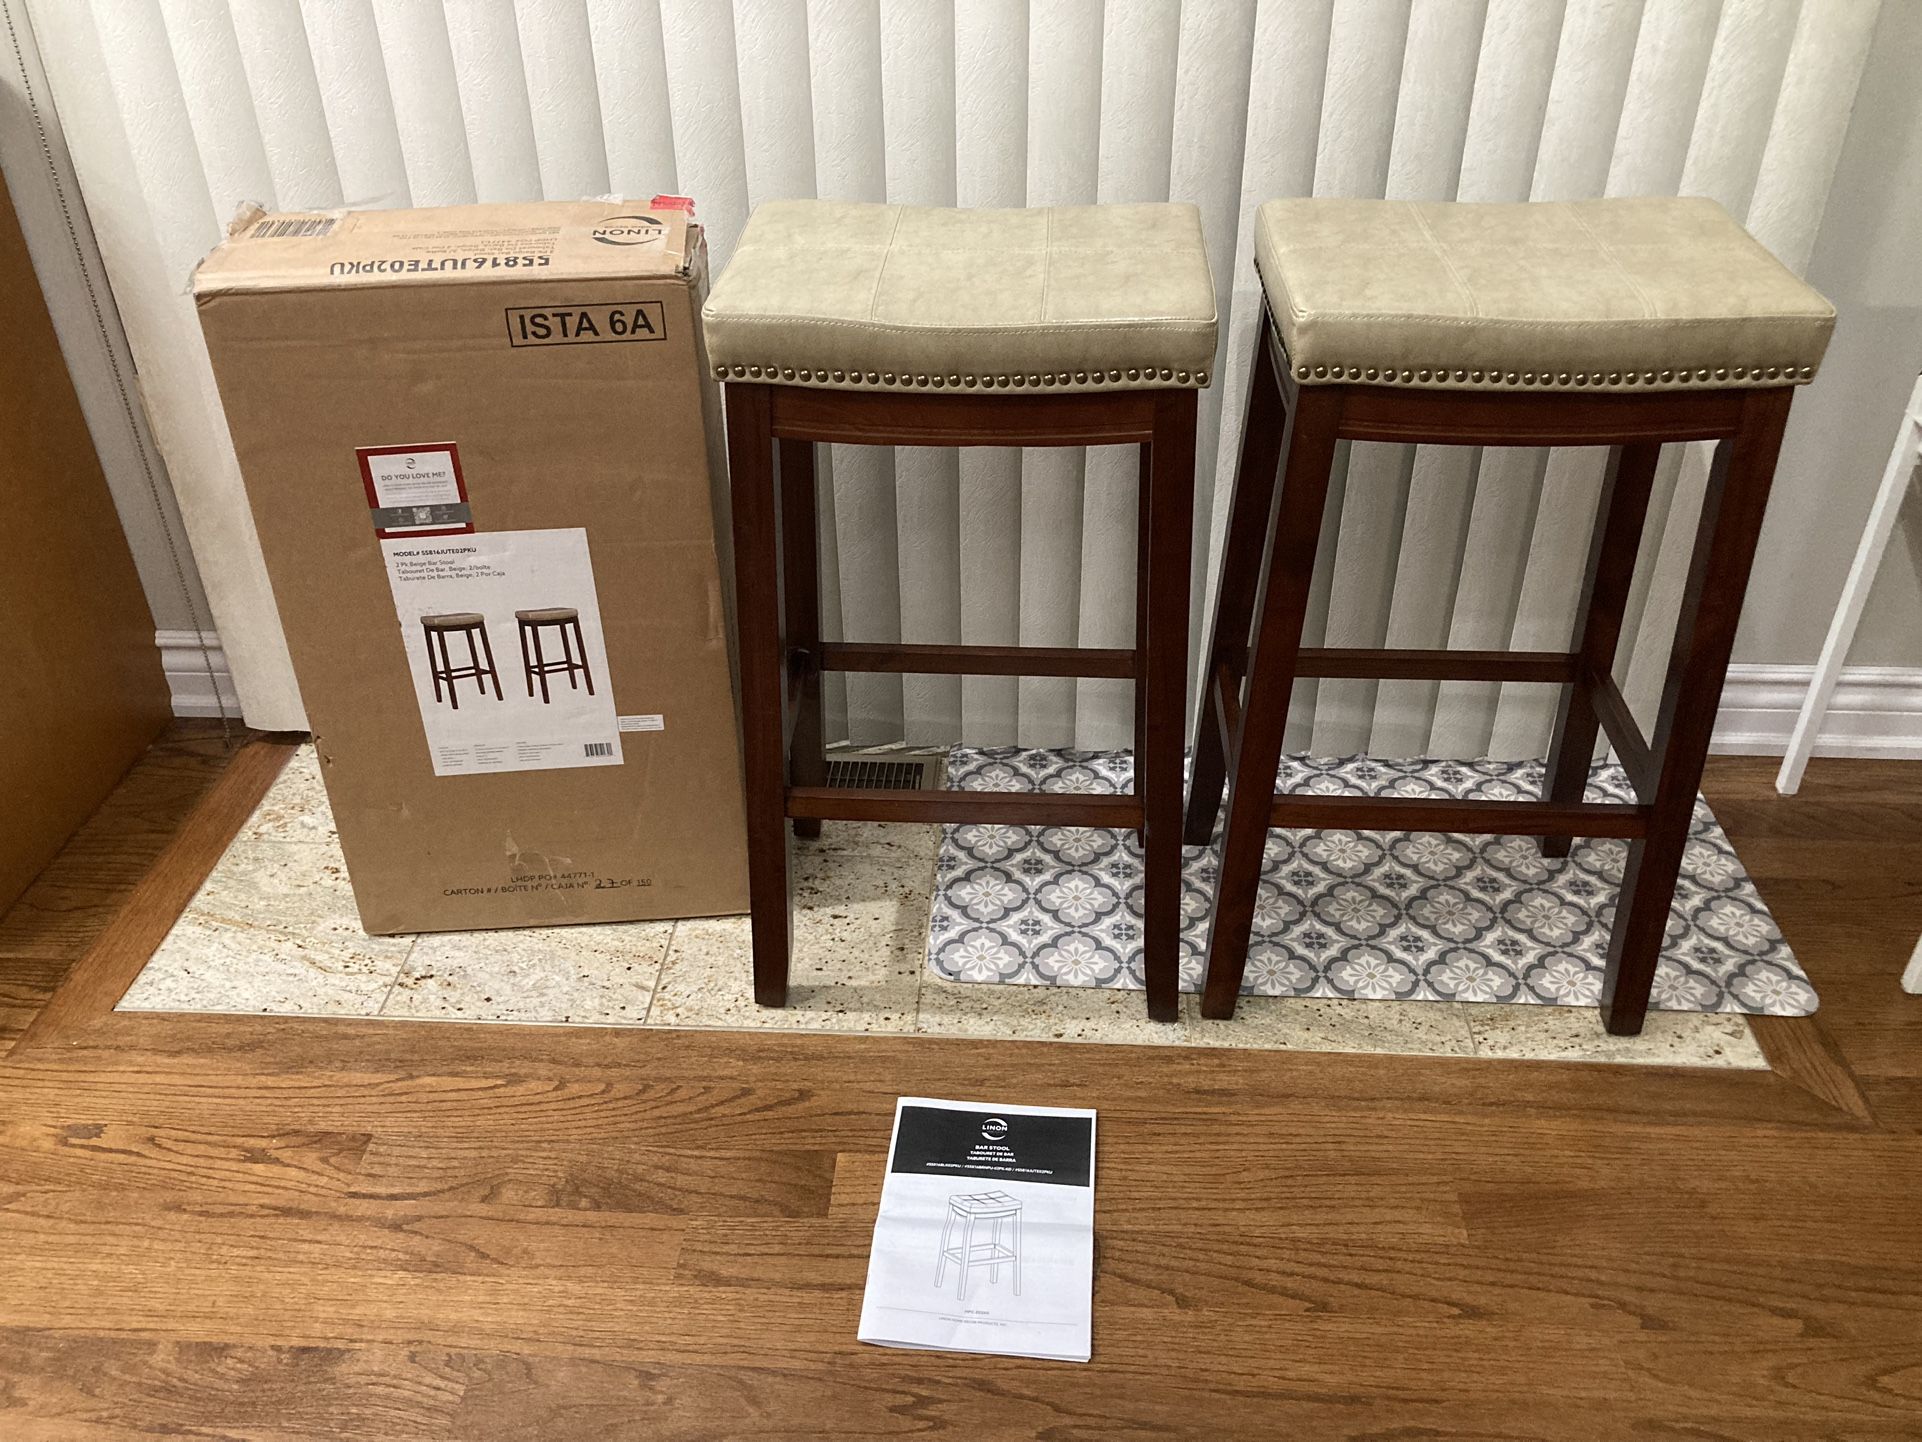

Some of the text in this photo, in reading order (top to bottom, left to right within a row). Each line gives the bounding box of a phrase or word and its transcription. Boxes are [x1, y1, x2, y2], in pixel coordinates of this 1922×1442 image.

[519, 308, 655, 340] ISTA 6A
[510, 875, 536, 883] LHDP
[443, 888, 484, 896] CARTON
[620, 879, 633, 887] OF
[982, 1124, 1008, 1132] LINON
